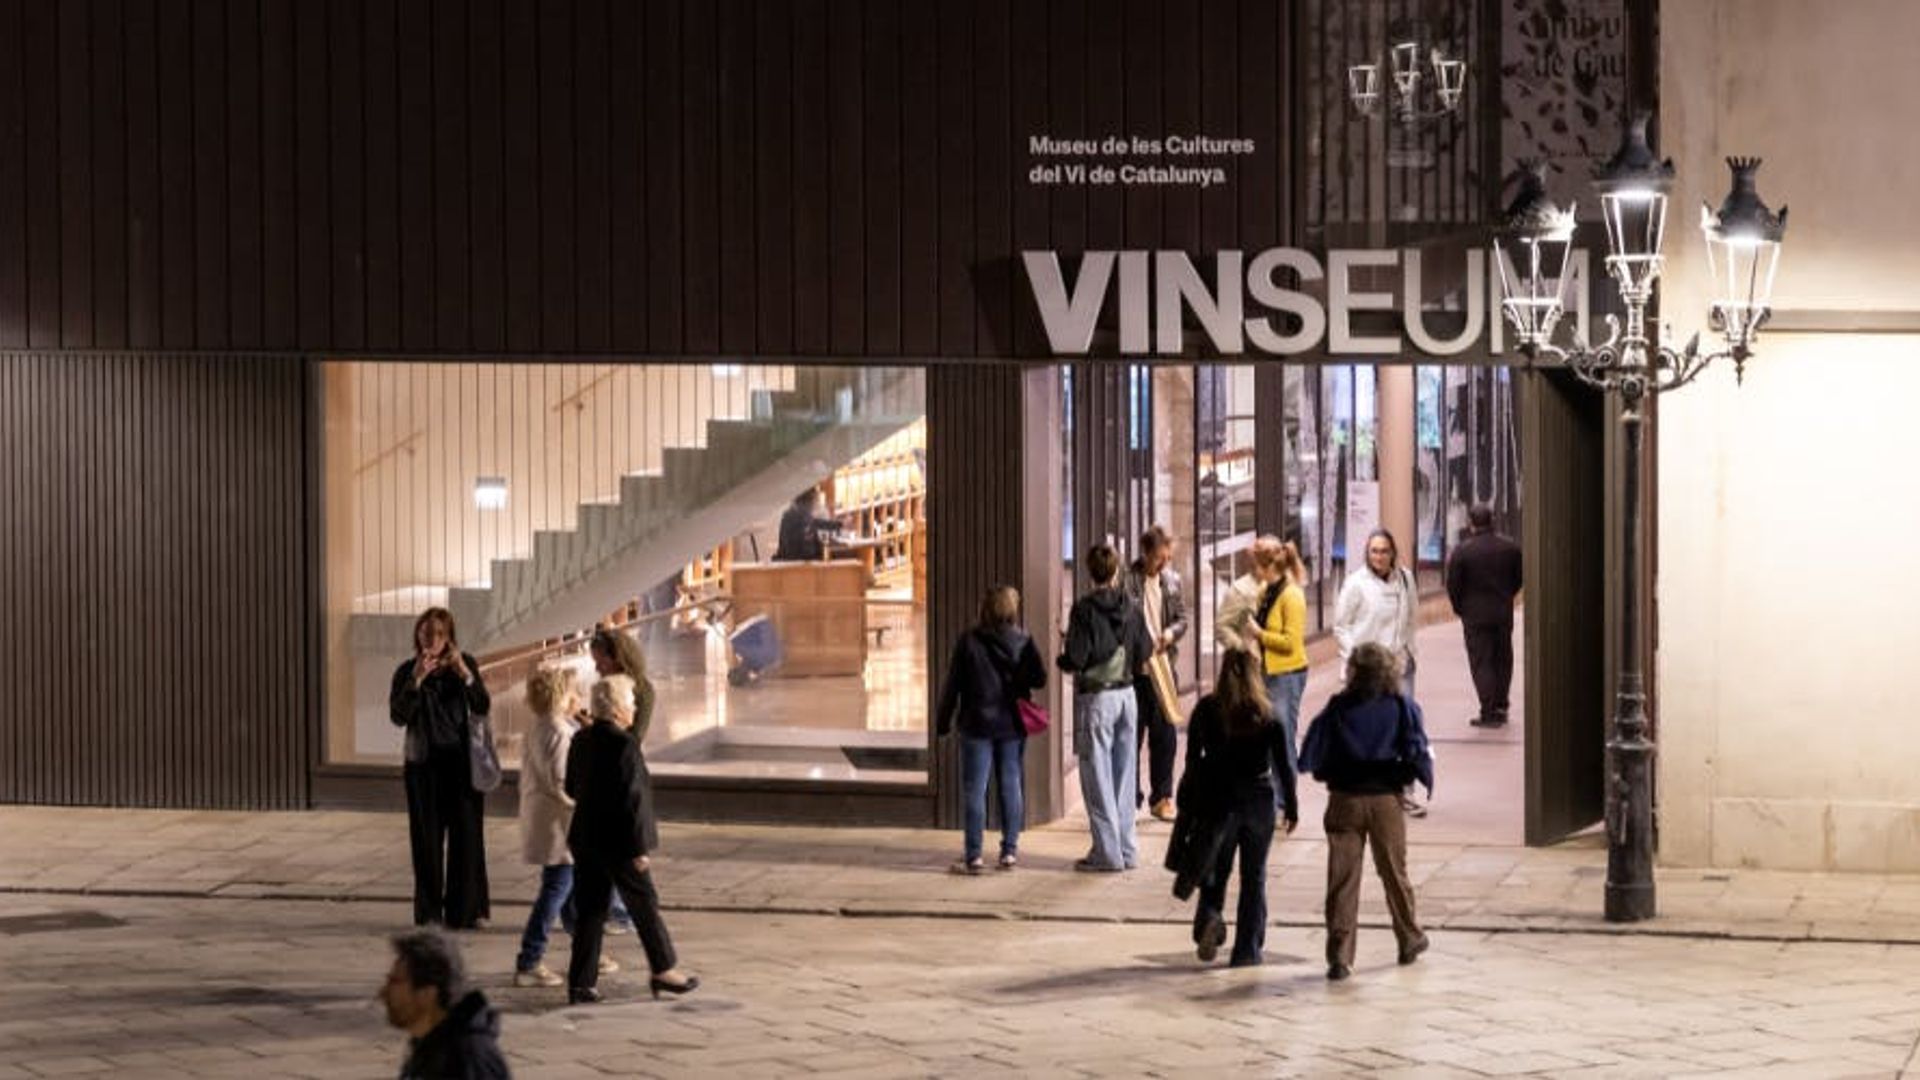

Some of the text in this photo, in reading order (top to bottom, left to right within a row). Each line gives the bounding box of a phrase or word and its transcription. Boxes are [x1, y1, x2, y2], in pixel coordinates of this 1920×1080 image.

[1029, 135, 1255, 155] Museu de les Cultures
[1028, 164, 1226, 188] del Vi de Catalunya
[1022, 247, 1589, 354] VINSEUM
